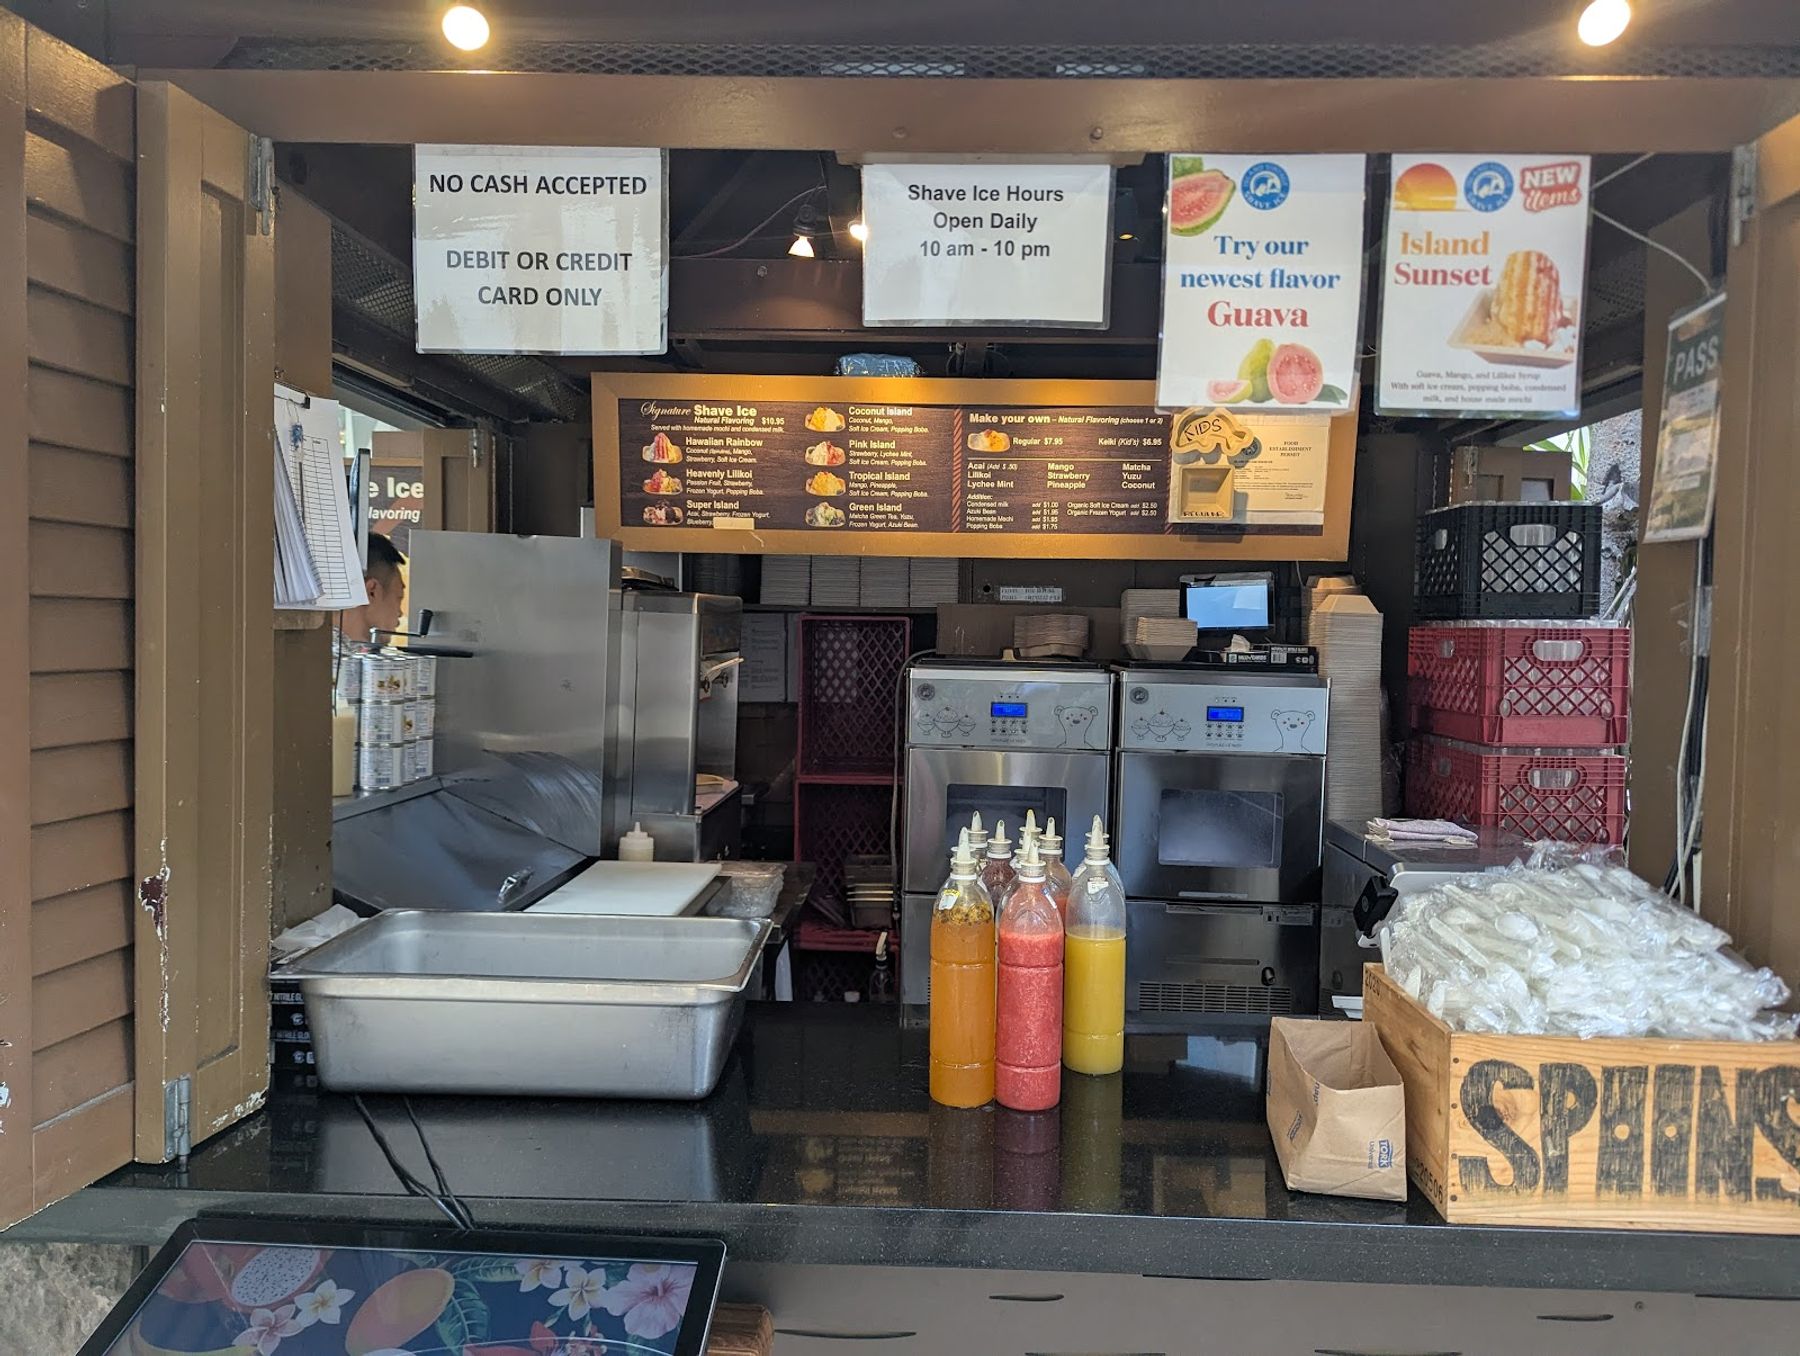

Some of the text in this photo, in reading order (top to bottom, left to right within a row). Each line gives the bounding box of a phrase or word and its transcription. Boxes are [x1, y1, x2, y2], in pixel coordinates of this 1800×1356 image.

[430, 175, 647, 195] NO CASH ACCEPTED
[1523, 166, 1577, 189] NEW
[908, 185, 1064, 202] Shave Ice Hours
[934, 212, 1038, 232] Open Daily
[920, 241, 941, 256] 10
[946, 244, 974, 256] am
[994, 241, 1014, 257] 10
[1022, 244, 1050, 259] pm
[1214, 235, 1309, 260] Try our
[1402, 231, 1489, 256] Island
[447, 250, 632, 271] DEBIT OR CREDIT
[1181, 269, 1340, 289] newest flavor
[1394, 263, 1493, 286] Sunset
[478, 287, 602, 306] CARD ONLY
[1207, 301, 1308, 327] Guava
[1673, 335, 1718, 384] PASS
[641, 401, 757, 420] Signature Shave Ice
[849, 407, 912, 416] Coconut Island
[969, 413, 998, 423] Make
[1002, 415, 1025, 425] your
[1086, 416, 1119, 425] Flavoring
[722, 417, 755, 426] Flavoring
[1185, 419, 1222, 441] KIDS
[686, 437, 763, 447] Hawaiian Rainbow
[849, 440, 895, 448] Pink Island
[1013, 437, 1063, 446] Regular $7.95
[1143, 438, 1162, 446] $6.95
[686, 469, 725, 479] Heavenly
[1048, 463, 1074, 471] Mango
[849, 471, 910, 481] Tropical Island
[1048, 473, 1090, 481] Strawberry
[1122, 472, 1141, 480] Yuzu
[387, 477, 424, 498] Ice
[967, 481, 994, 489] Lychee
[687, 500, 739, 510] Super Island
[849, 503, 902, 512] Green Island
[368, 507, 420, 522] lavoring
[1379, 1140, 1389, 1168] TORK
